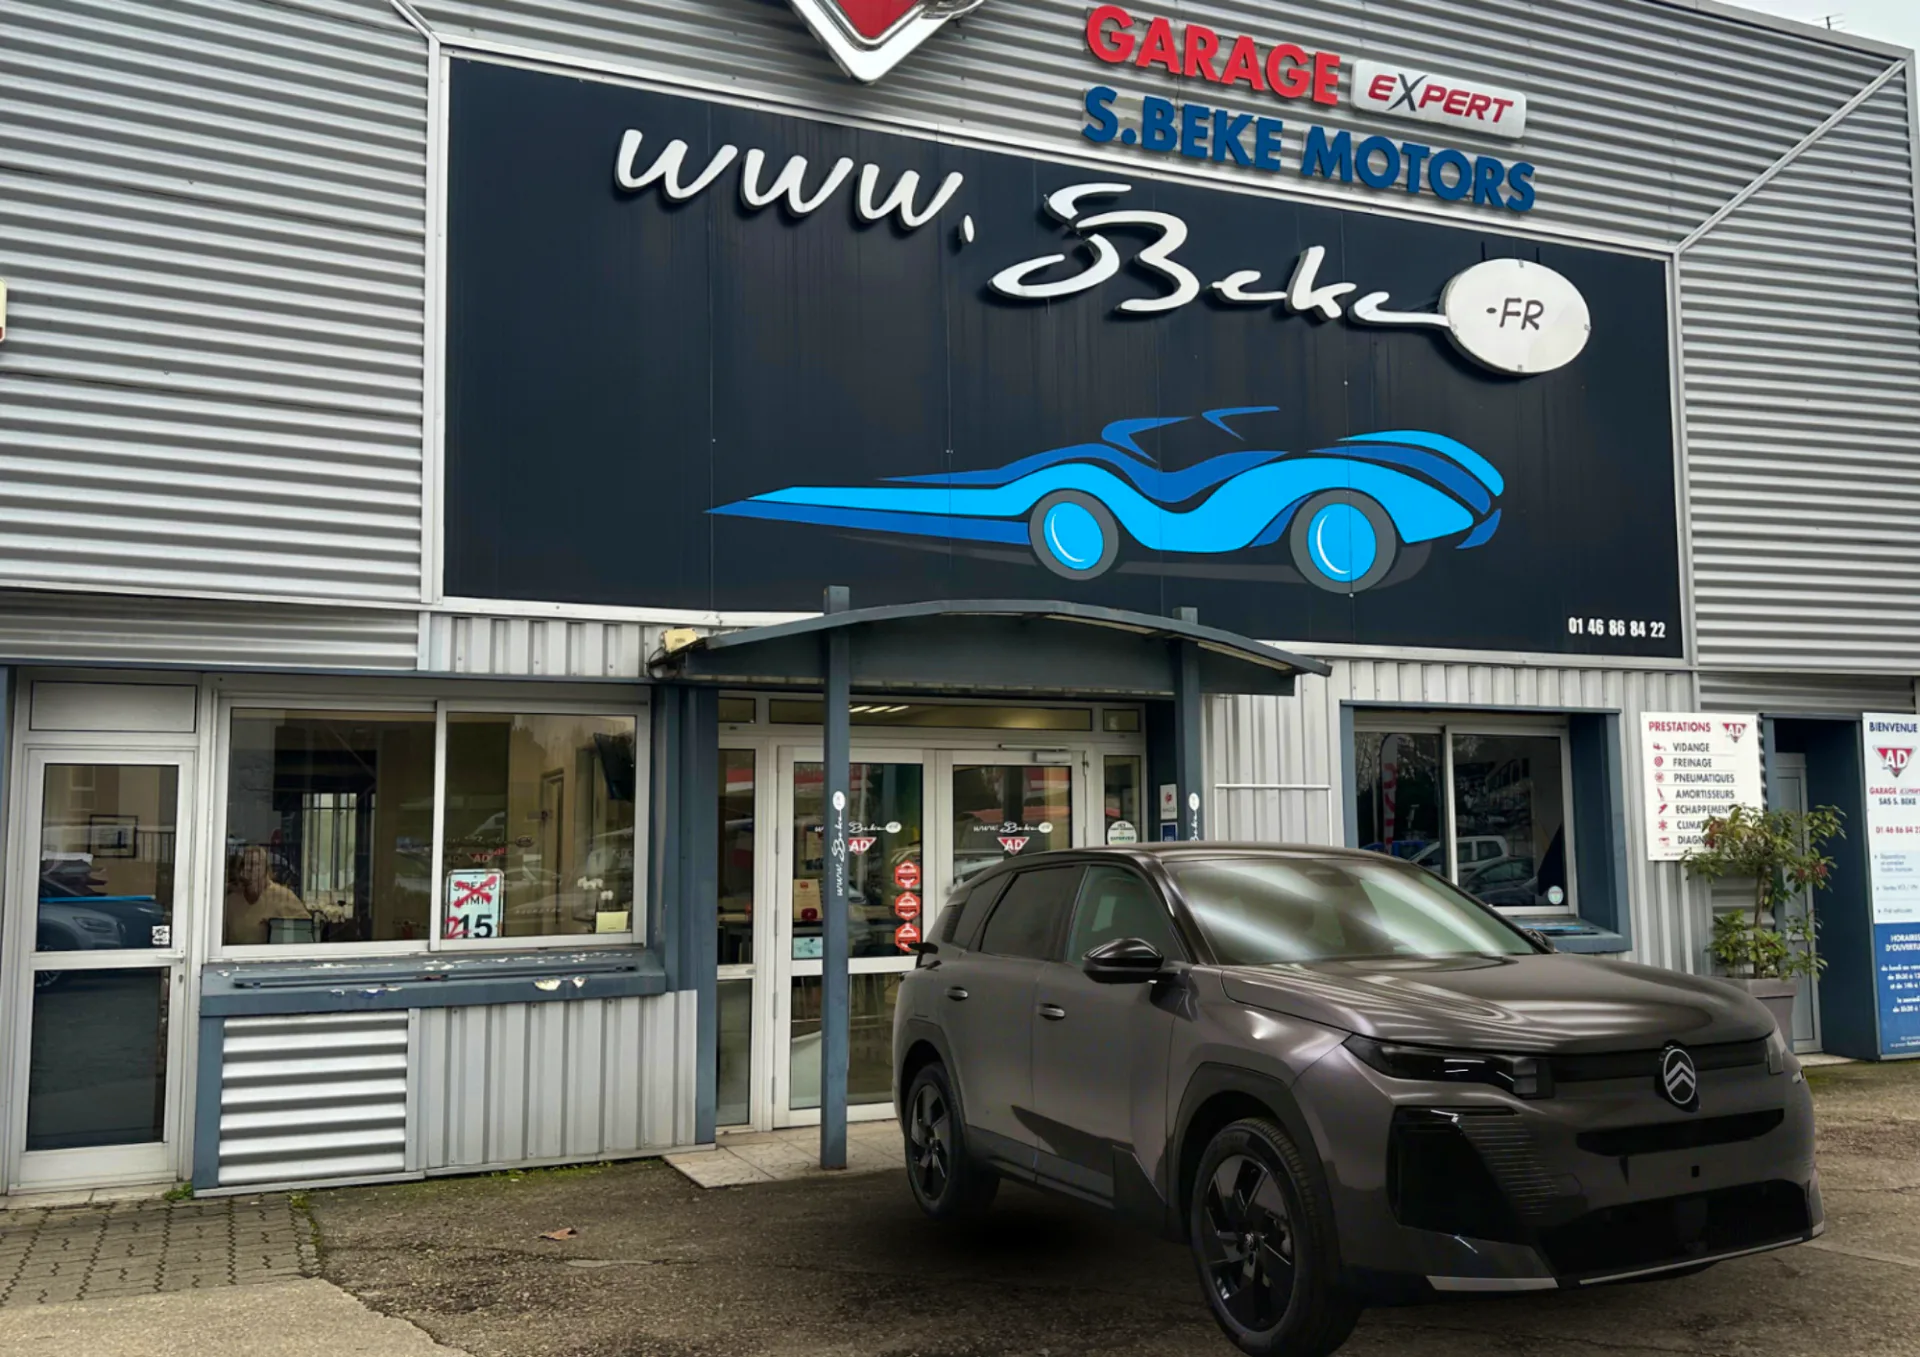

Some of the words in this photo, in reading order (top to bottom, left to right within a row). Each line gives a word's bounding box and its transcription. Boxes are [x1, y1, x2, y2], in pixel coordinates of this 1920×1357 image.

[1085, 4, 1341, 106] GARAGE
[1081, 86, 1283, 171] S.BEKE
[1301, 125, 1536, 212] MOTORS
[1568, 617, 1583, 634] 01
[1587, 618, 1604, 636] 46
[1608, 619, 1625, 636] 86
[1630, 620, 1646, 637] 84
[1650, 621, 1666, 638] 22
[1649, 721, 1711, 732] PRESTATIONS
[1869, 722, 1918, 733] BIENVENUE
[1673, 742, 1710, 752] VIDANGE
[1673, 758, 1712, 767] FREINAGE
[1884, 749, 1908, 768] AD
[1674, 773, 1735, 784] PNEUMATIQUES
[1675, 789, 1735, 799] AMORTISSEURS
[1869, 786, 1896, 795] GARAGE
[849, 840, 870, 851] AD
[1004, 840, 1023, 850] AD
